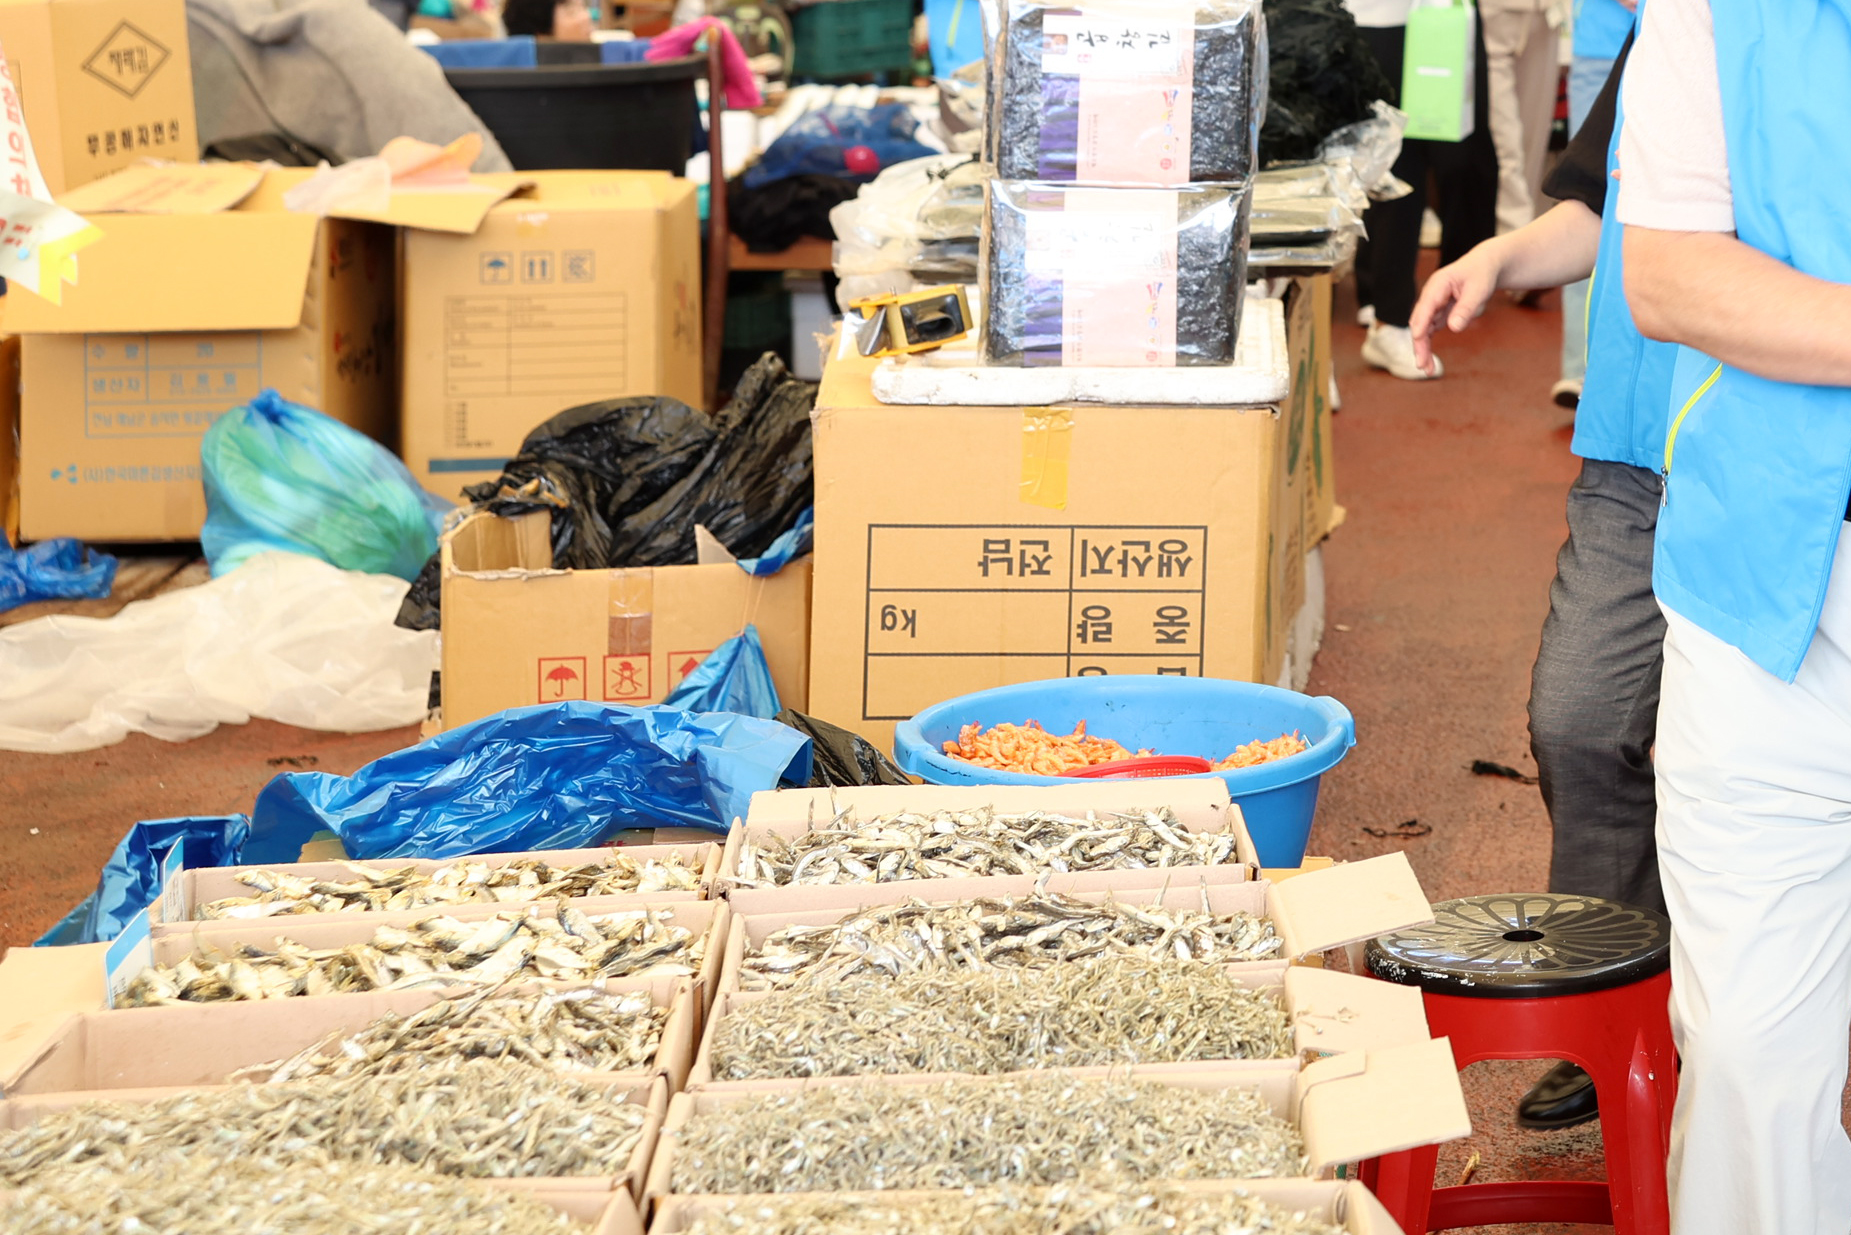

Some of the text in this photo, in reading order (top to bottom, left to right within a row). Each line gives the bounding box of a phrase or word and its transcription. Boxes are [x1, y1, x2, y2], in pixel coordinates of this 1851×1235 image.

[977, 538, 1194, 578] 생산지 전남
[880, 604, 918, 638] kg
